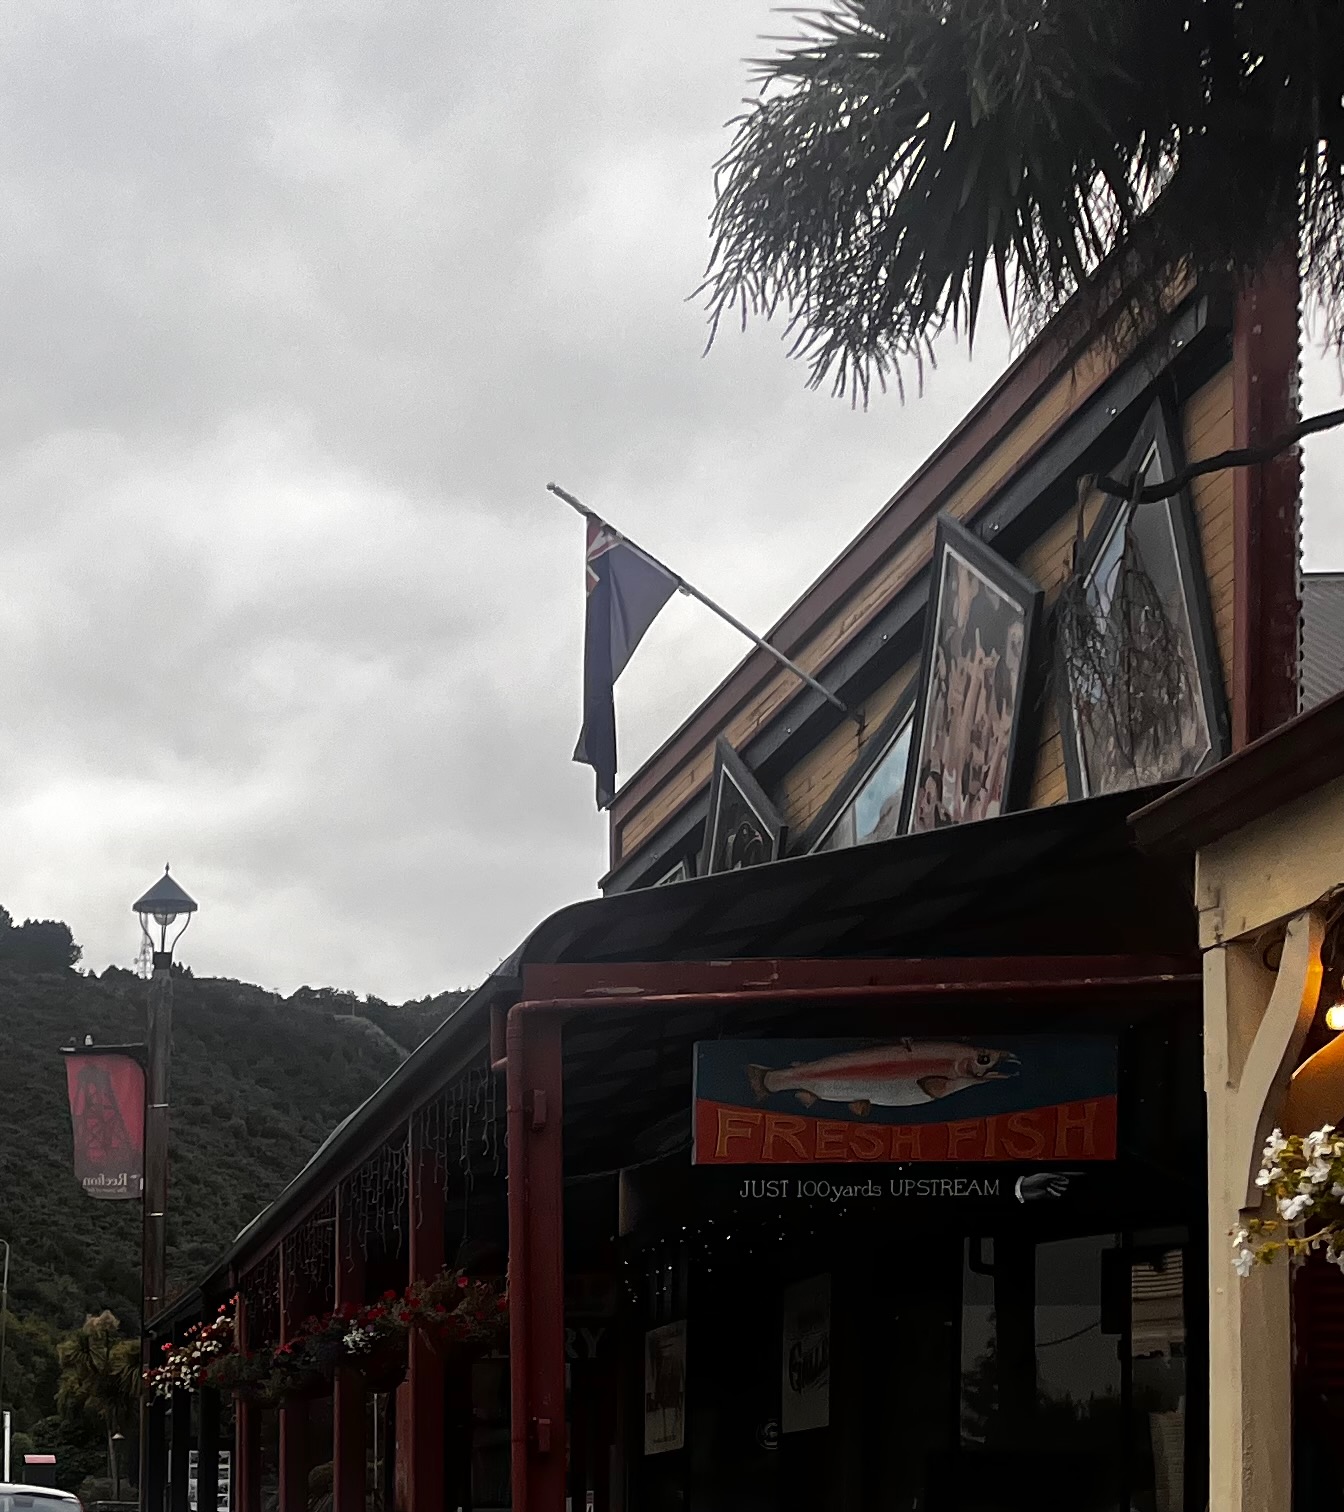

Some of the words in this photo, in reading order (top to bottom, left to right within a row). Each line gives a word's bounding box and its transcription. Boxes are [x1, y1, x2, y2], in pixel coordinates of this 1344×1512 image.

[715, 1108, 922, 1160] FRESH
[945, 1101, 1100, 1160] FISH
[739, 1179, 789, 1198] JUST
[797, 1179, 882, 1202] 100yards
[890, 1179, 1000, 1197] UPSTREAM
